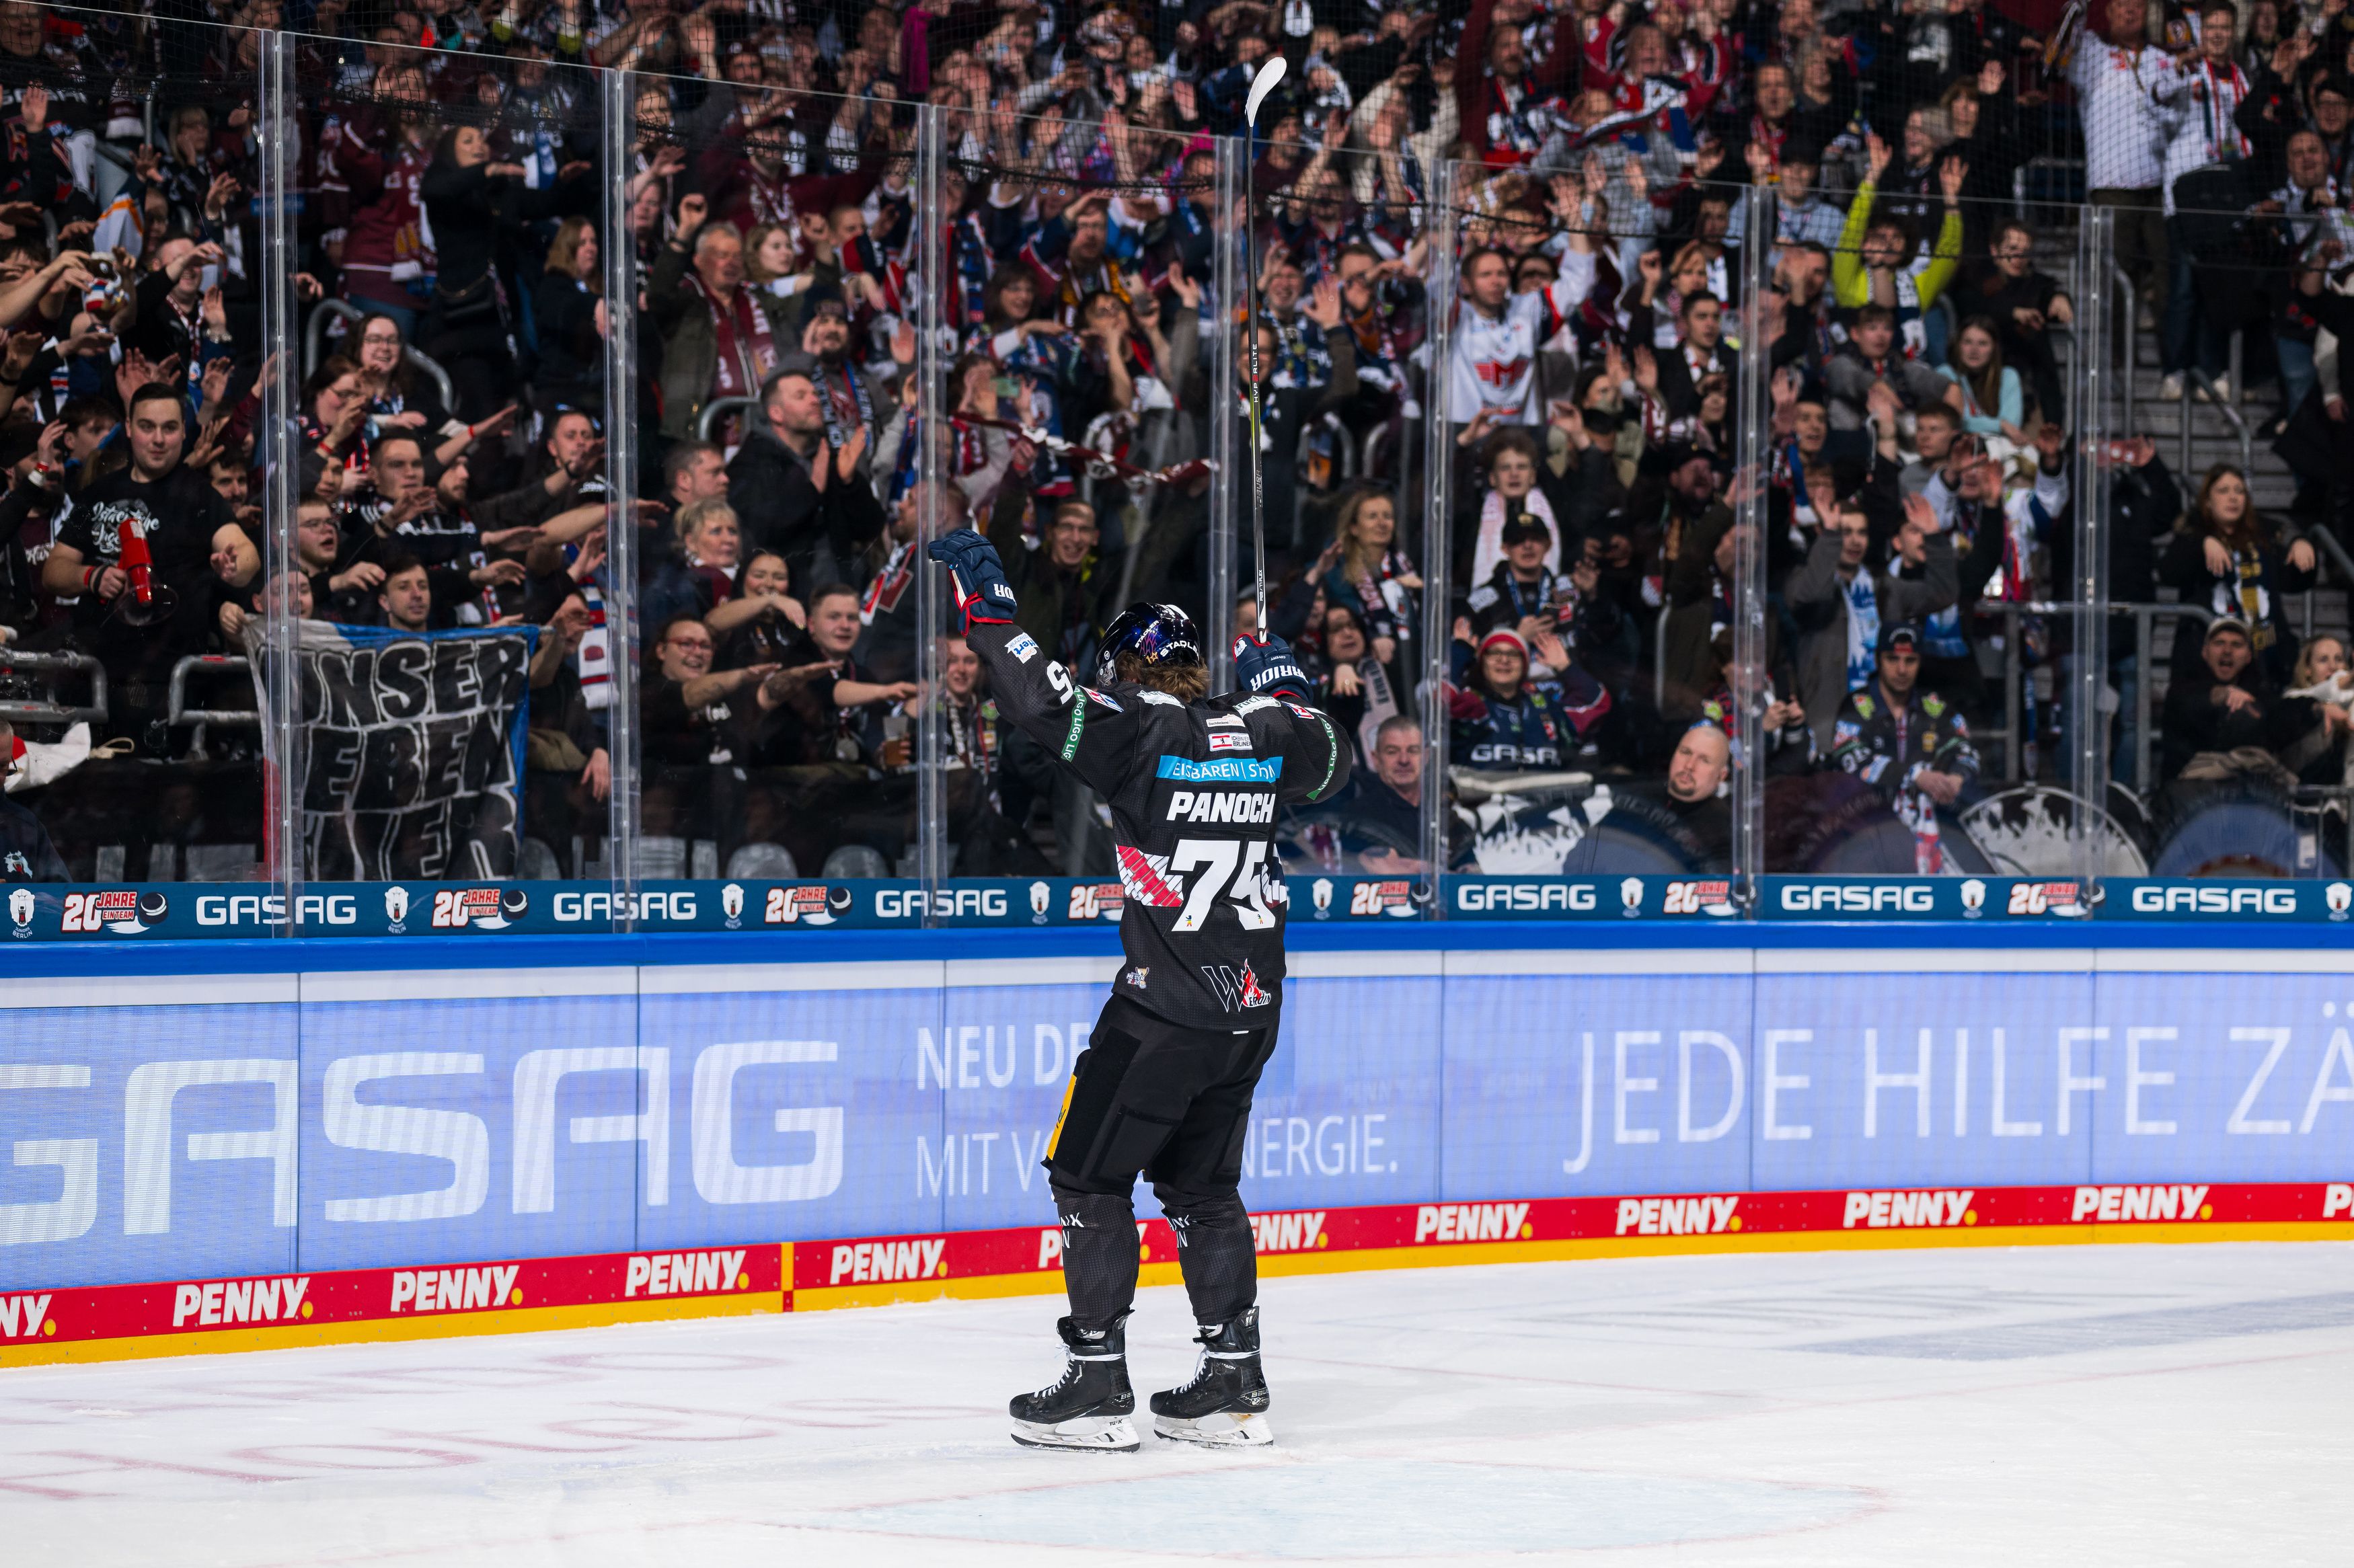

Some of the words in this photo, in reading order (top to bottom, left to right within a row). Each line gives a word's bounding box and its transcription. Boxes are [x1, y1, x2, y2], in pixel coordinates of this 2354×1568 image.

[1047, 660, 1073, 705] 5
[1070, 717, 1082, 742] LIGO
[1173, 762, 1240, 779] EISBÄREN
[1329, 742, 1337, 767] LIGO
[1166, 791, 1276, 823] PANOCH
[1170, 839, 1276, 932] 75
[1351, 881, 1383, 914] 20
[1458, 884, 1596, 910] GASAG
[1663, 881, 1700, 914] 20
[1781, 885, 1934, 912] GASAG
[2008, 883, 2047, 914] 20
[2132, 886, 2296, 914] GASAG
[62, 894, 102, 931] 20
[96, 892, 137, 908] JAHRE
[196, 896, 356, 925] GASAG
[432, 890, 469, 927] 20
[463, 889, 500, 905] JAHRE
[554, 892, 697, 921] GASAG
[765, 888, 799, 923] 20
[876, 889, 1008, 918] GASAG
[1068, 885, 1100, 920] 20
[12, 929, 33, 939] BERLIN
[917, 1024, 1016, 1090] NEU
[1562, 1029, 1813, 1174] JEDE
[1864, 1027, 2179, 1138] HILFE
[0, 1040, 844, 1245] GASAG
[916, 1133, 999, 1198] MIT
